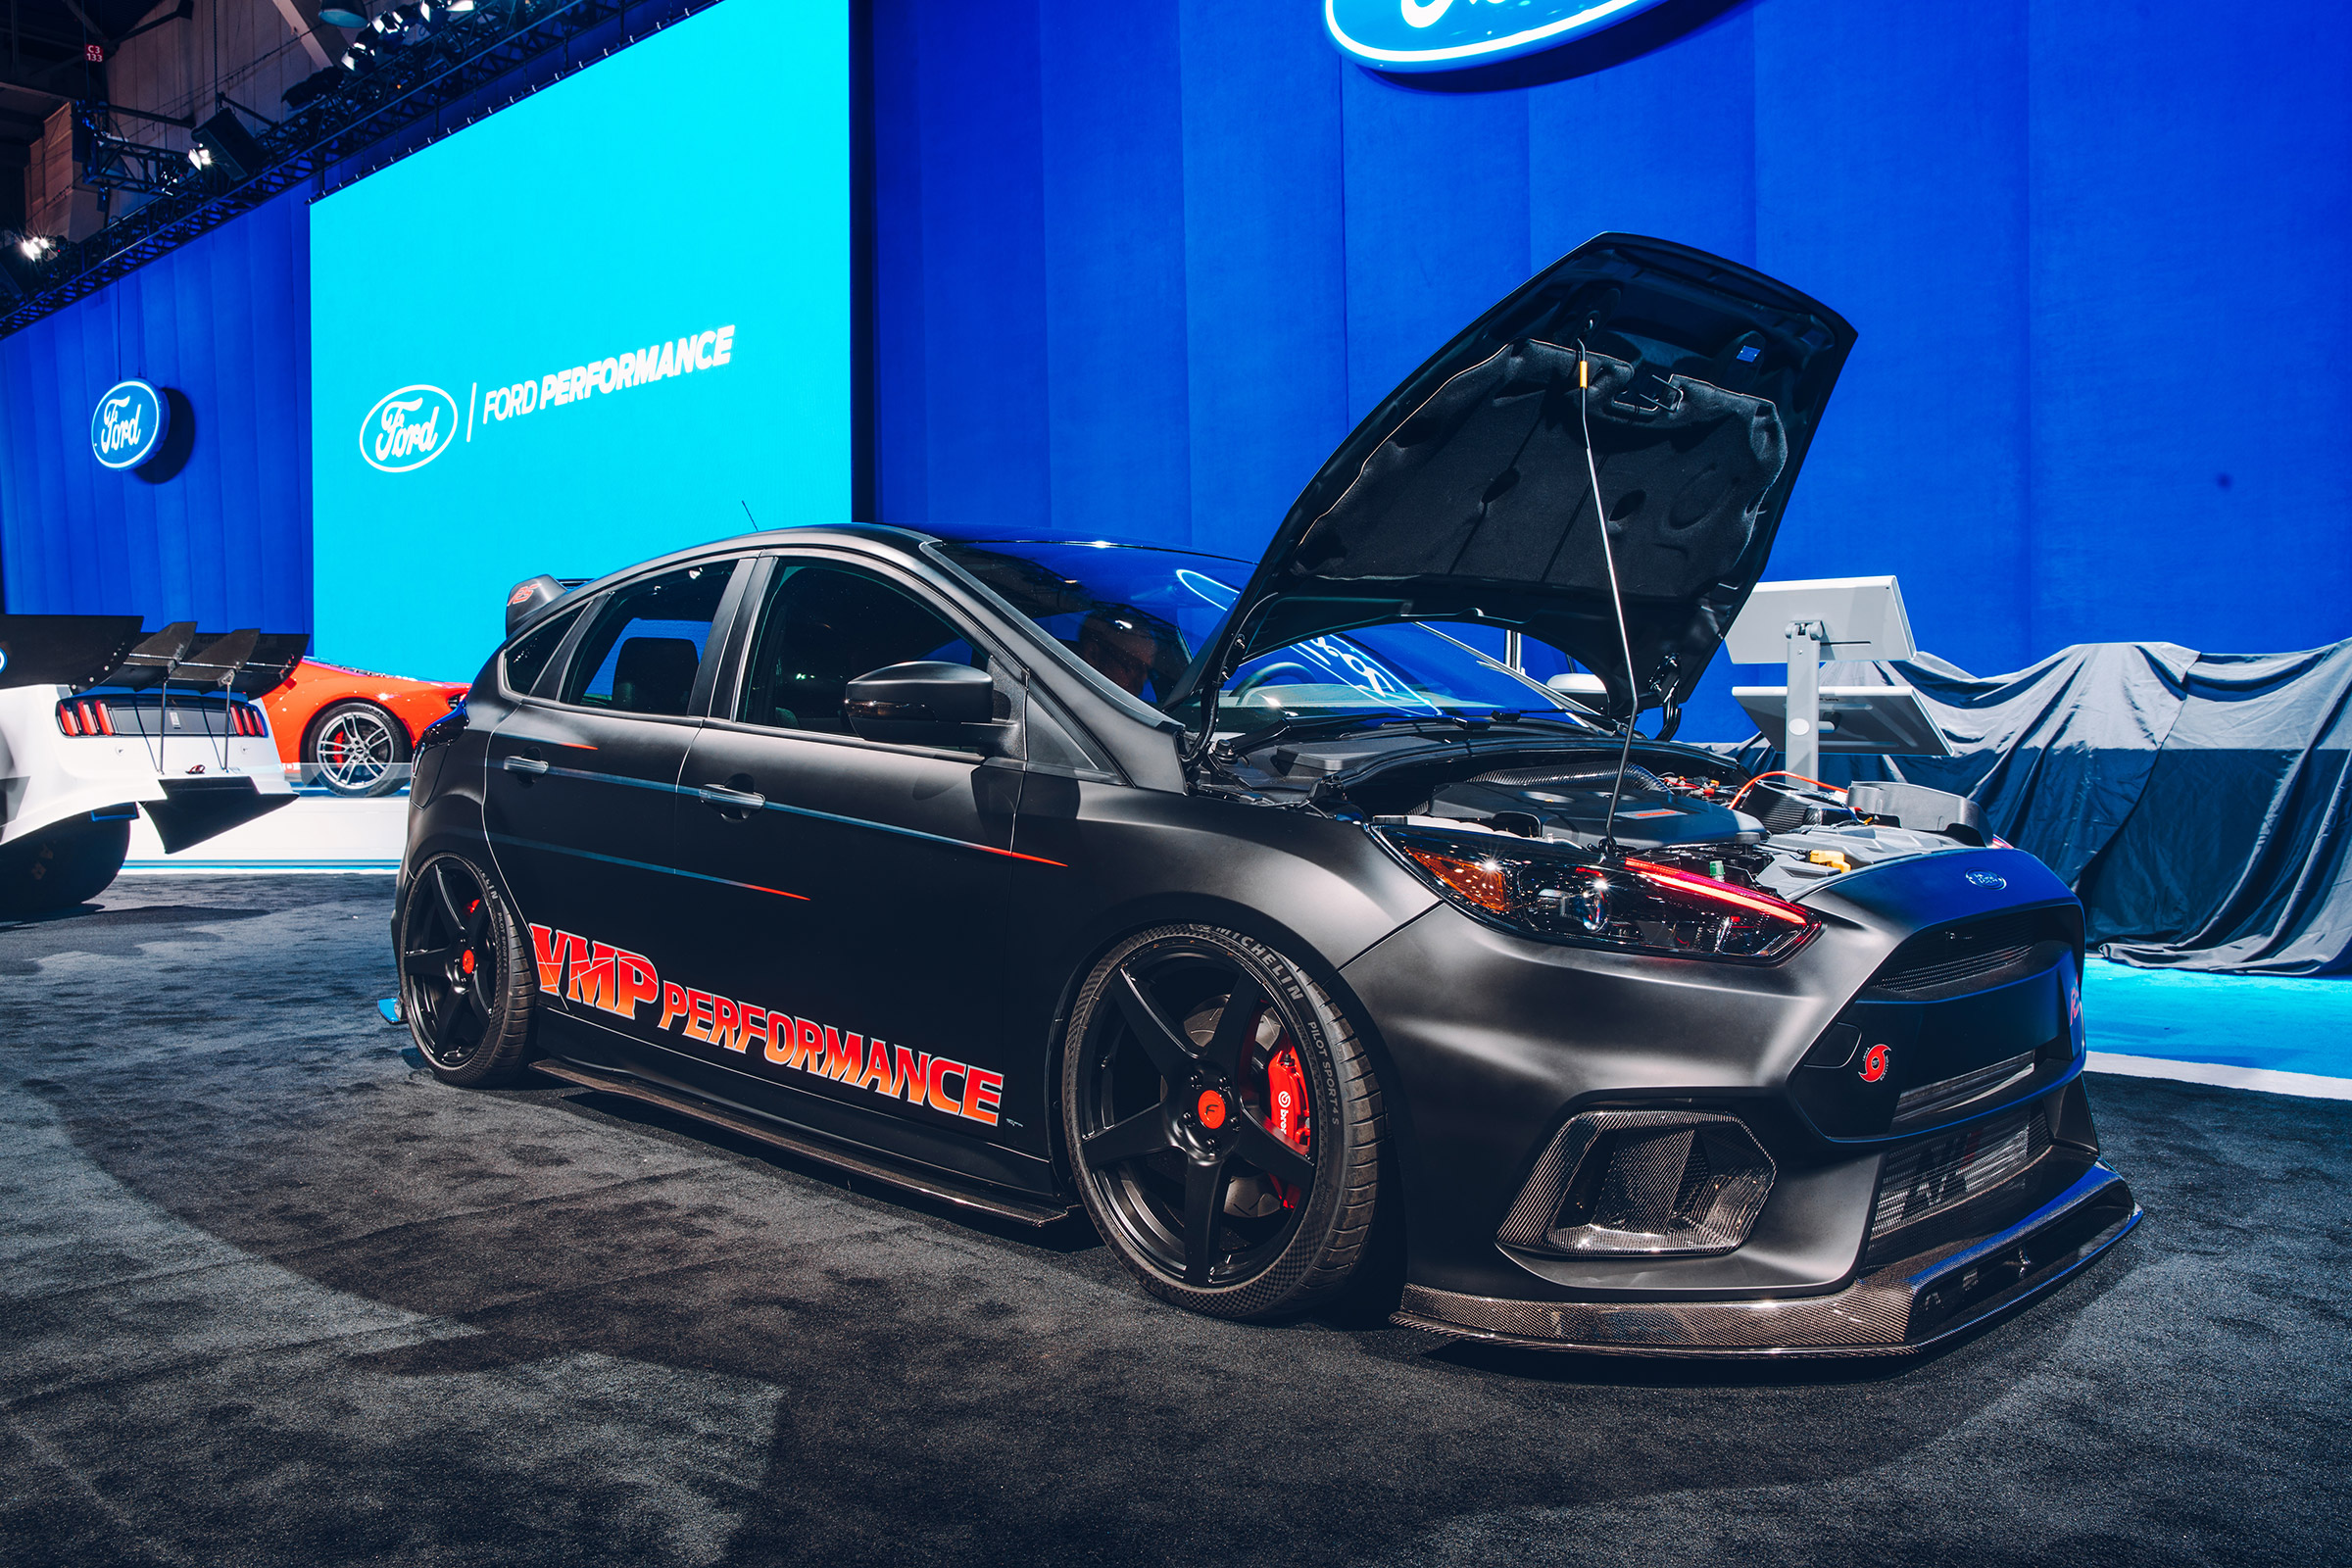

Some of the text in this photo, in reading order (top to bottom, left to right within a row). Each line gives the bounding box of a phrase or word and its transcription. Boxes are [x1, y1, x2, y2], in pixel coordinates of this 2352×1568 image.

[87, 53, 103, 62] 133
[482, 324, 736, 424] FORD PERFORMANCE
[101, 395, 141, 454] Ford
[375, 397, 441, 462] Ford
[507, 583, 542, 607] RS
[1215, 927, 1304, 1000] MICHELIN
[529, 922, 1004, 1127] VMP PERFORMANCE
[1307, 1021, 1328, 1057] PILOT
